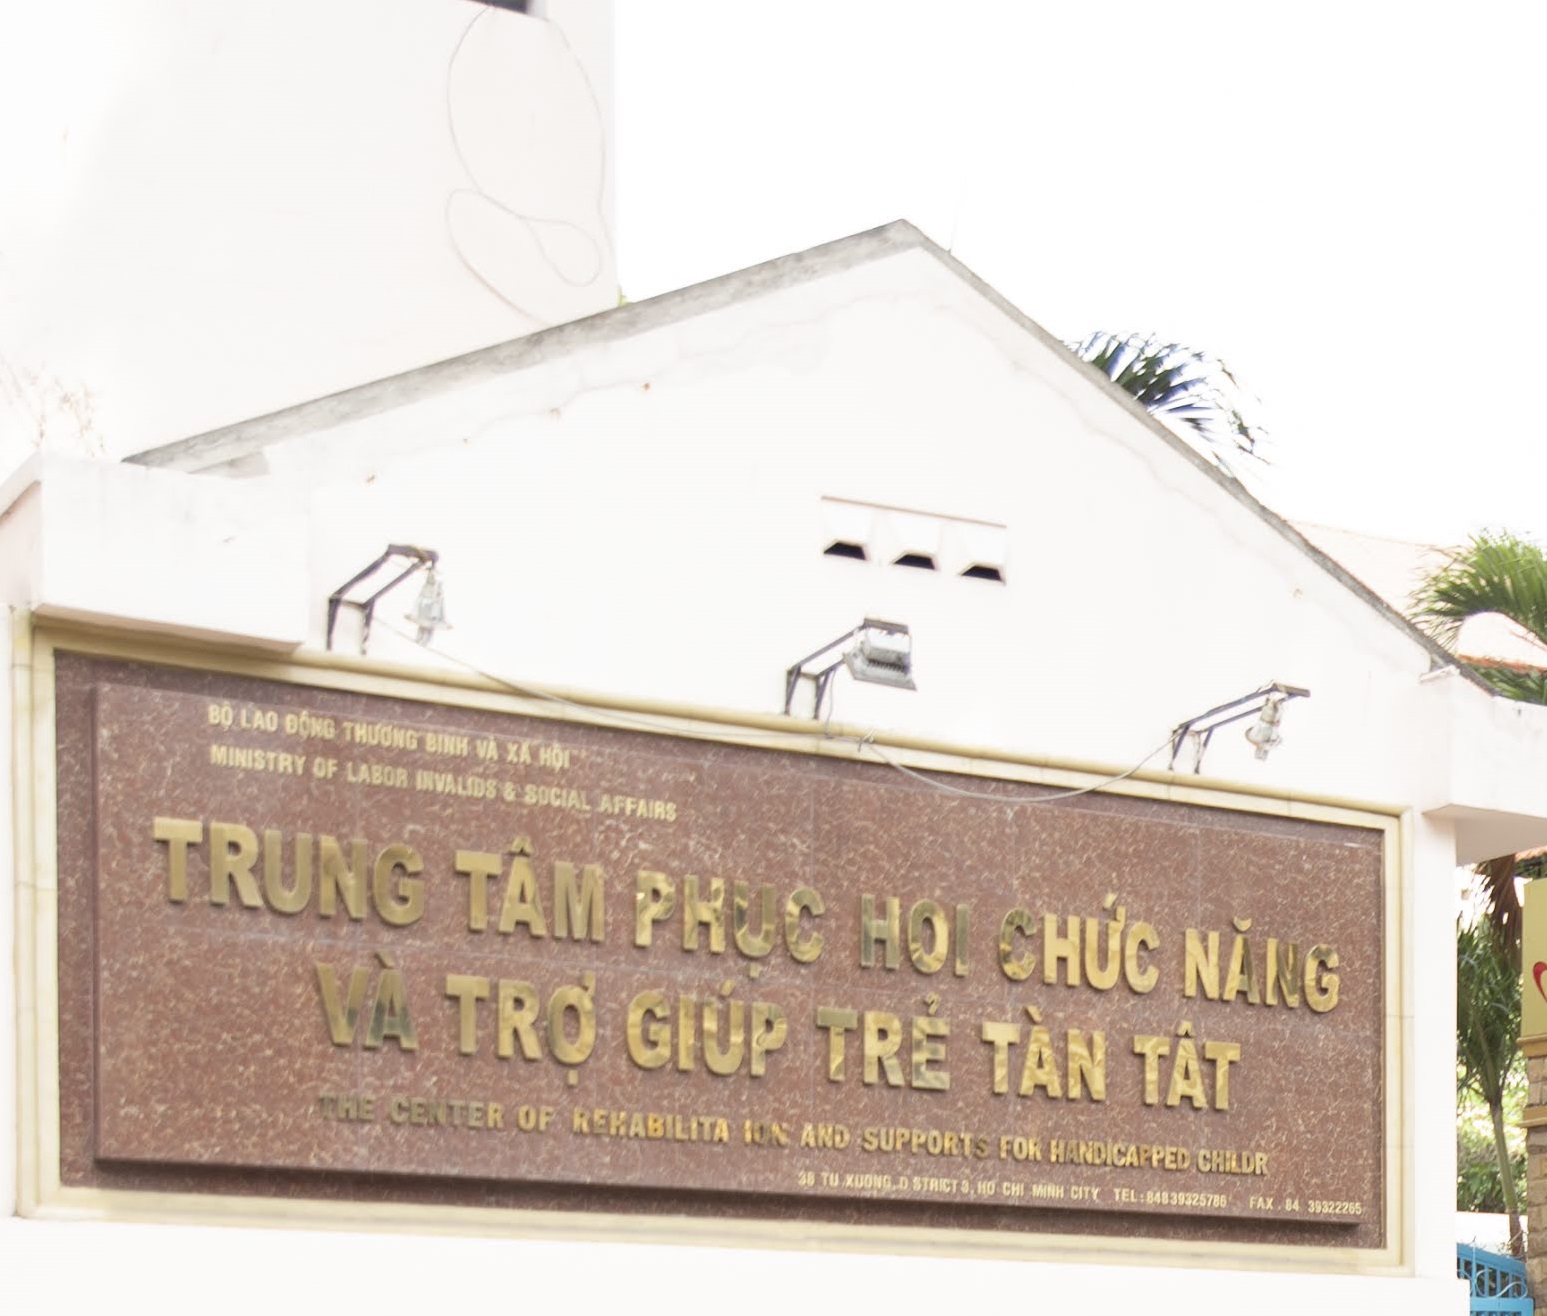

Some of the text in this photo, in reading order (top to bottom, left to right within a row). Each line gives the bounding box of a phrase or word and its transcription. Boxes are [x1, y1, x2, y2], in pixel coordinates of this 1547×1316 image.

[208, 702, 233, 731] BỘ
[240, 708, 279, 732] LAO
[285, 710, 336, 741] ĐỘNG
[426, 732, 469, 758] BINH
[477, 736, 498, 761] VÀ
[539, 740, 571, 772] HỘI
[210, 744, 678, 822] MINISTRY OF LABOR INVALIDS & SOCIAL AFFAIRS
[152, 816, 426, 928] TRUNG
[454, 836, 607, 944] TÂM
[635, 869, 826, 980] PHỤC
[999, 893, 1160, 996] CHỨC
[1183, 916, 1342, 1014] NĂNG
[315, 951, 420, 1052] VÀ
[445, 971, 598, 1086] TRỢ
[625, 979, 789, 1080] GIÚP
[816, 994, 952, 1092] TRẺ
[981, 1006, 1108, 1102] TÀN
[319, 1092, 376, 1123] THE
[388, 1096, 505, 1131] CENTER
[517, 1104, 553, 1132] OF
[800, 1122, 851, 1150] AND
[862, 1126, 991, 1159] SUPPORTS
[1000, 1135, 1042, 1163] FOR
[1050, 1138, 1191, 1172] HANDICAPPED
[1196, 1149, 1269, 1176] CHILDR
[1002, 1181, 1026, 1198] CHI
[1032, 1183, 1065, 1200] MINH
[1070, 1185, 1102, 1202] CITY
